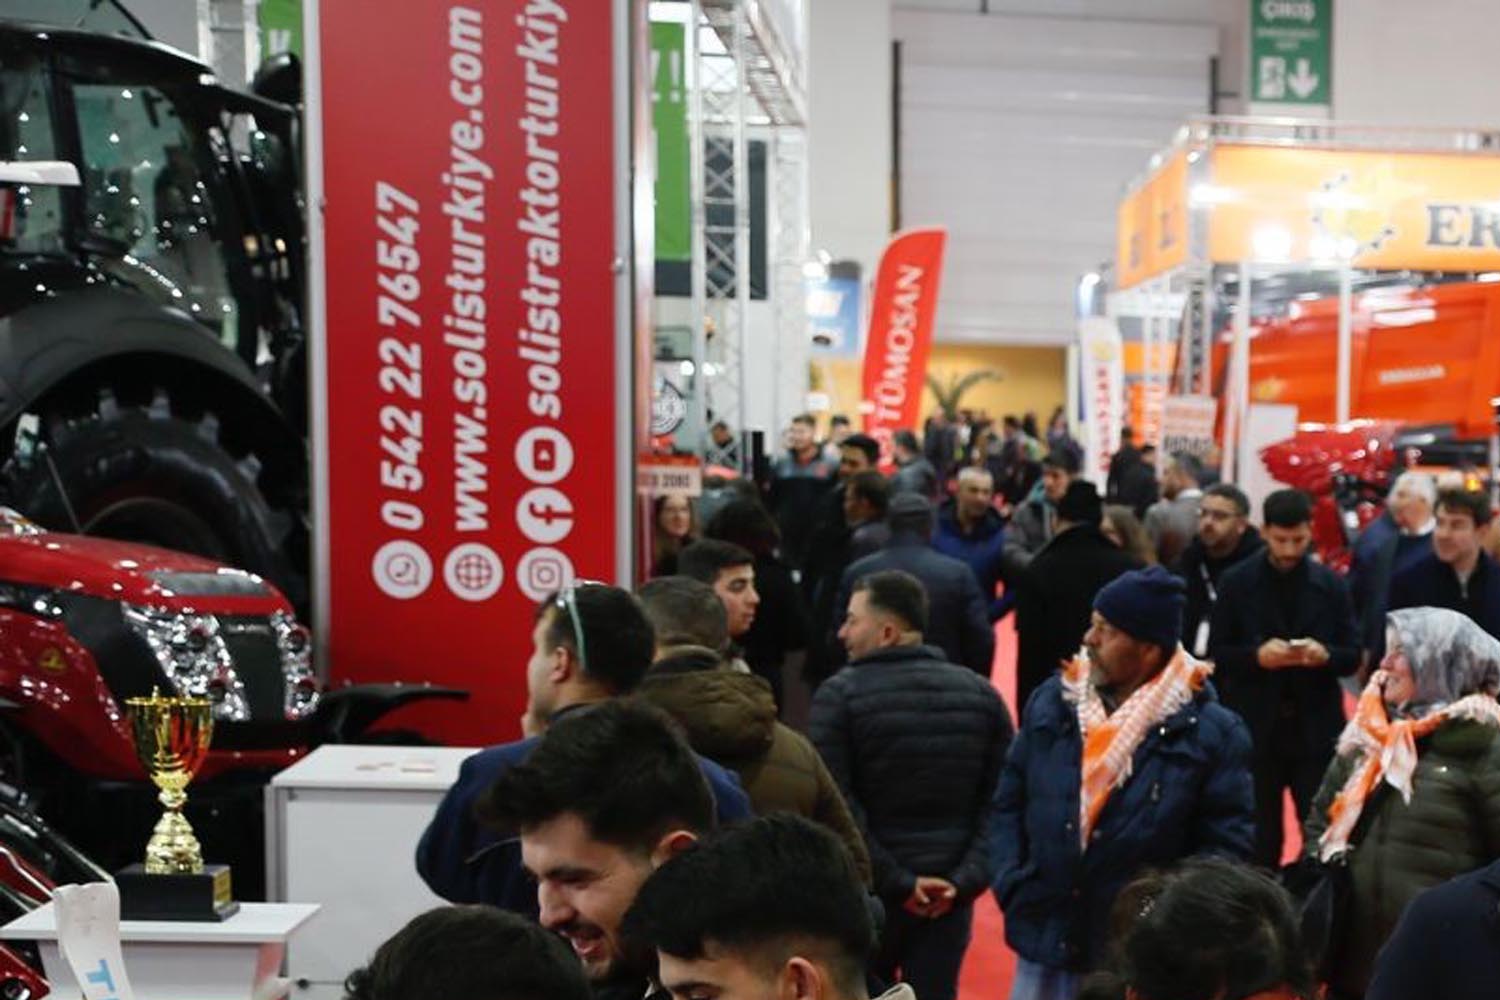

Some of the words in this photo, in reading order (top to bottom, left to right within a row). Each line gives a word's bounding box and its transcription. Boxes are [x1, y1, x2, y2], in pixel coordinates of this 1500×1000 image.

[375, 181, 421, 328] 76547
[441, 6, 494, 532] www.solisturkiye.com
[378, 338, 422, 398] 22
[379, 405, 424, 492] 542
[382, 500, 424, 531] 0
